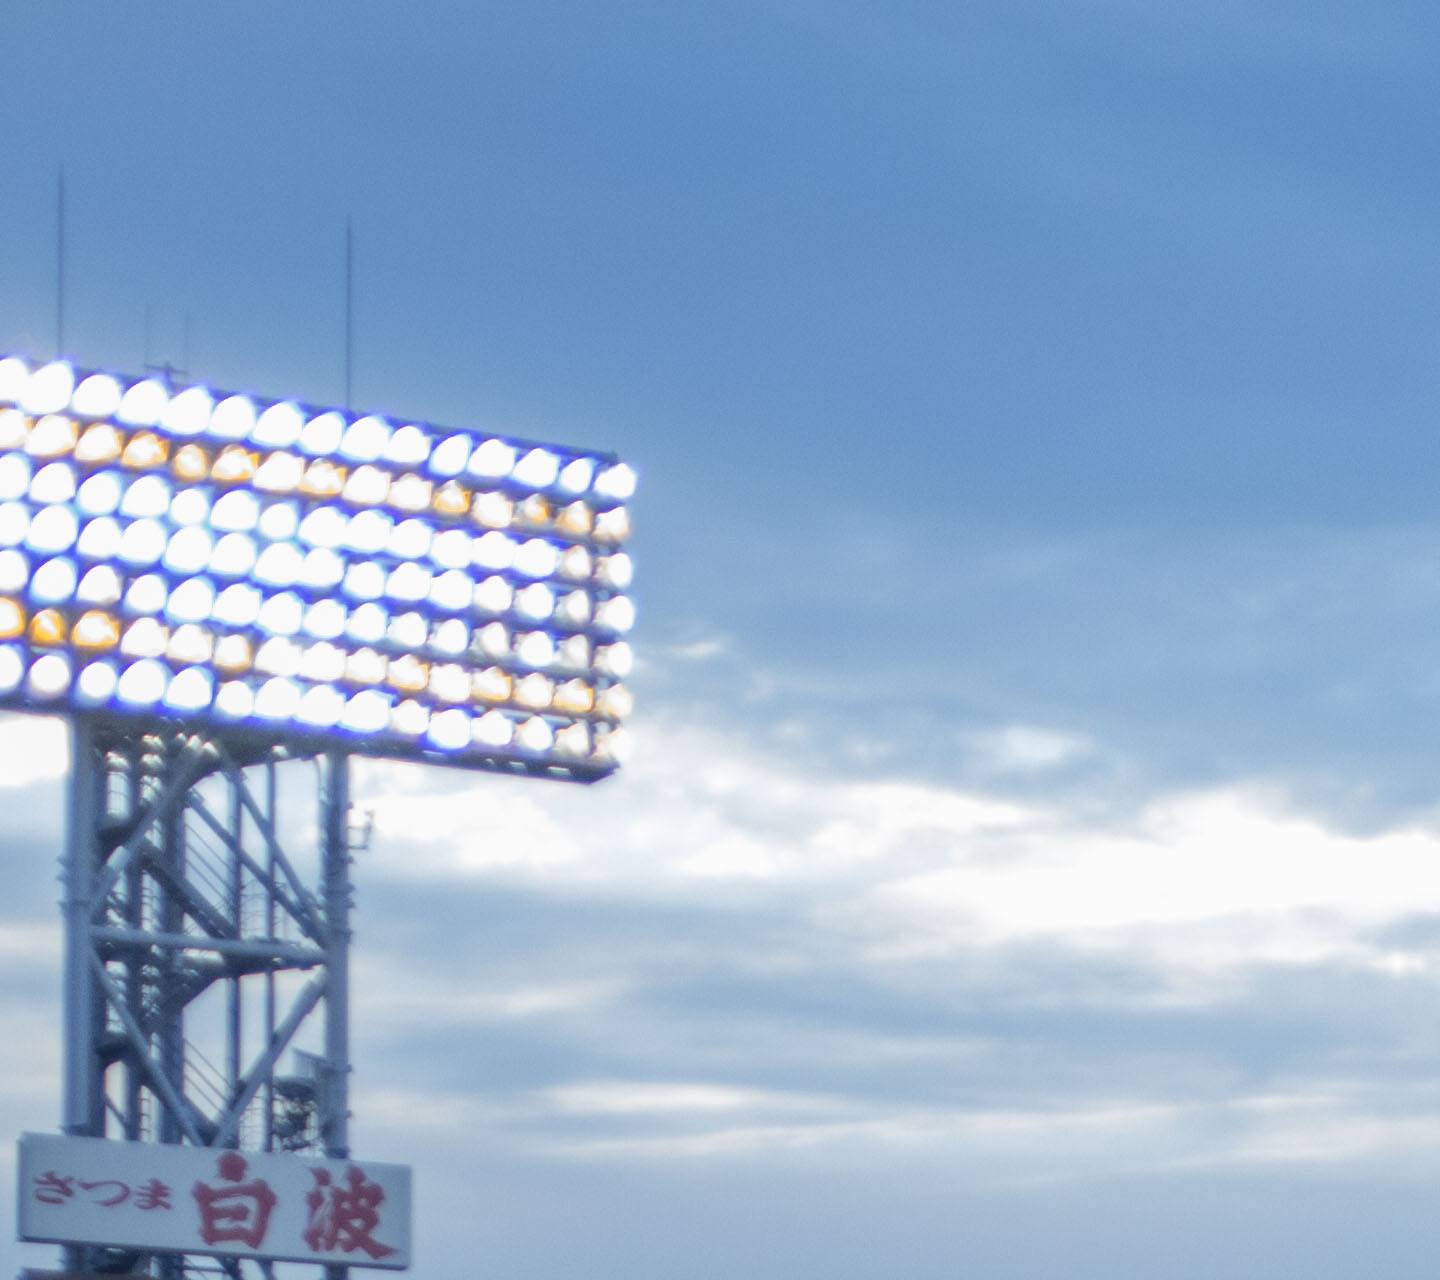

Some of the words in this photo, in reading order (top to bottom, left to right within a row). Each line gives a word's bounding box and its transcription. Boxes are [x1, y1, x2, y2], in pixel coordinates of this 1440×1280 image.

[34, 1171, 174, 1211] さつま
[192, 1150, 398, 1261] 白波
